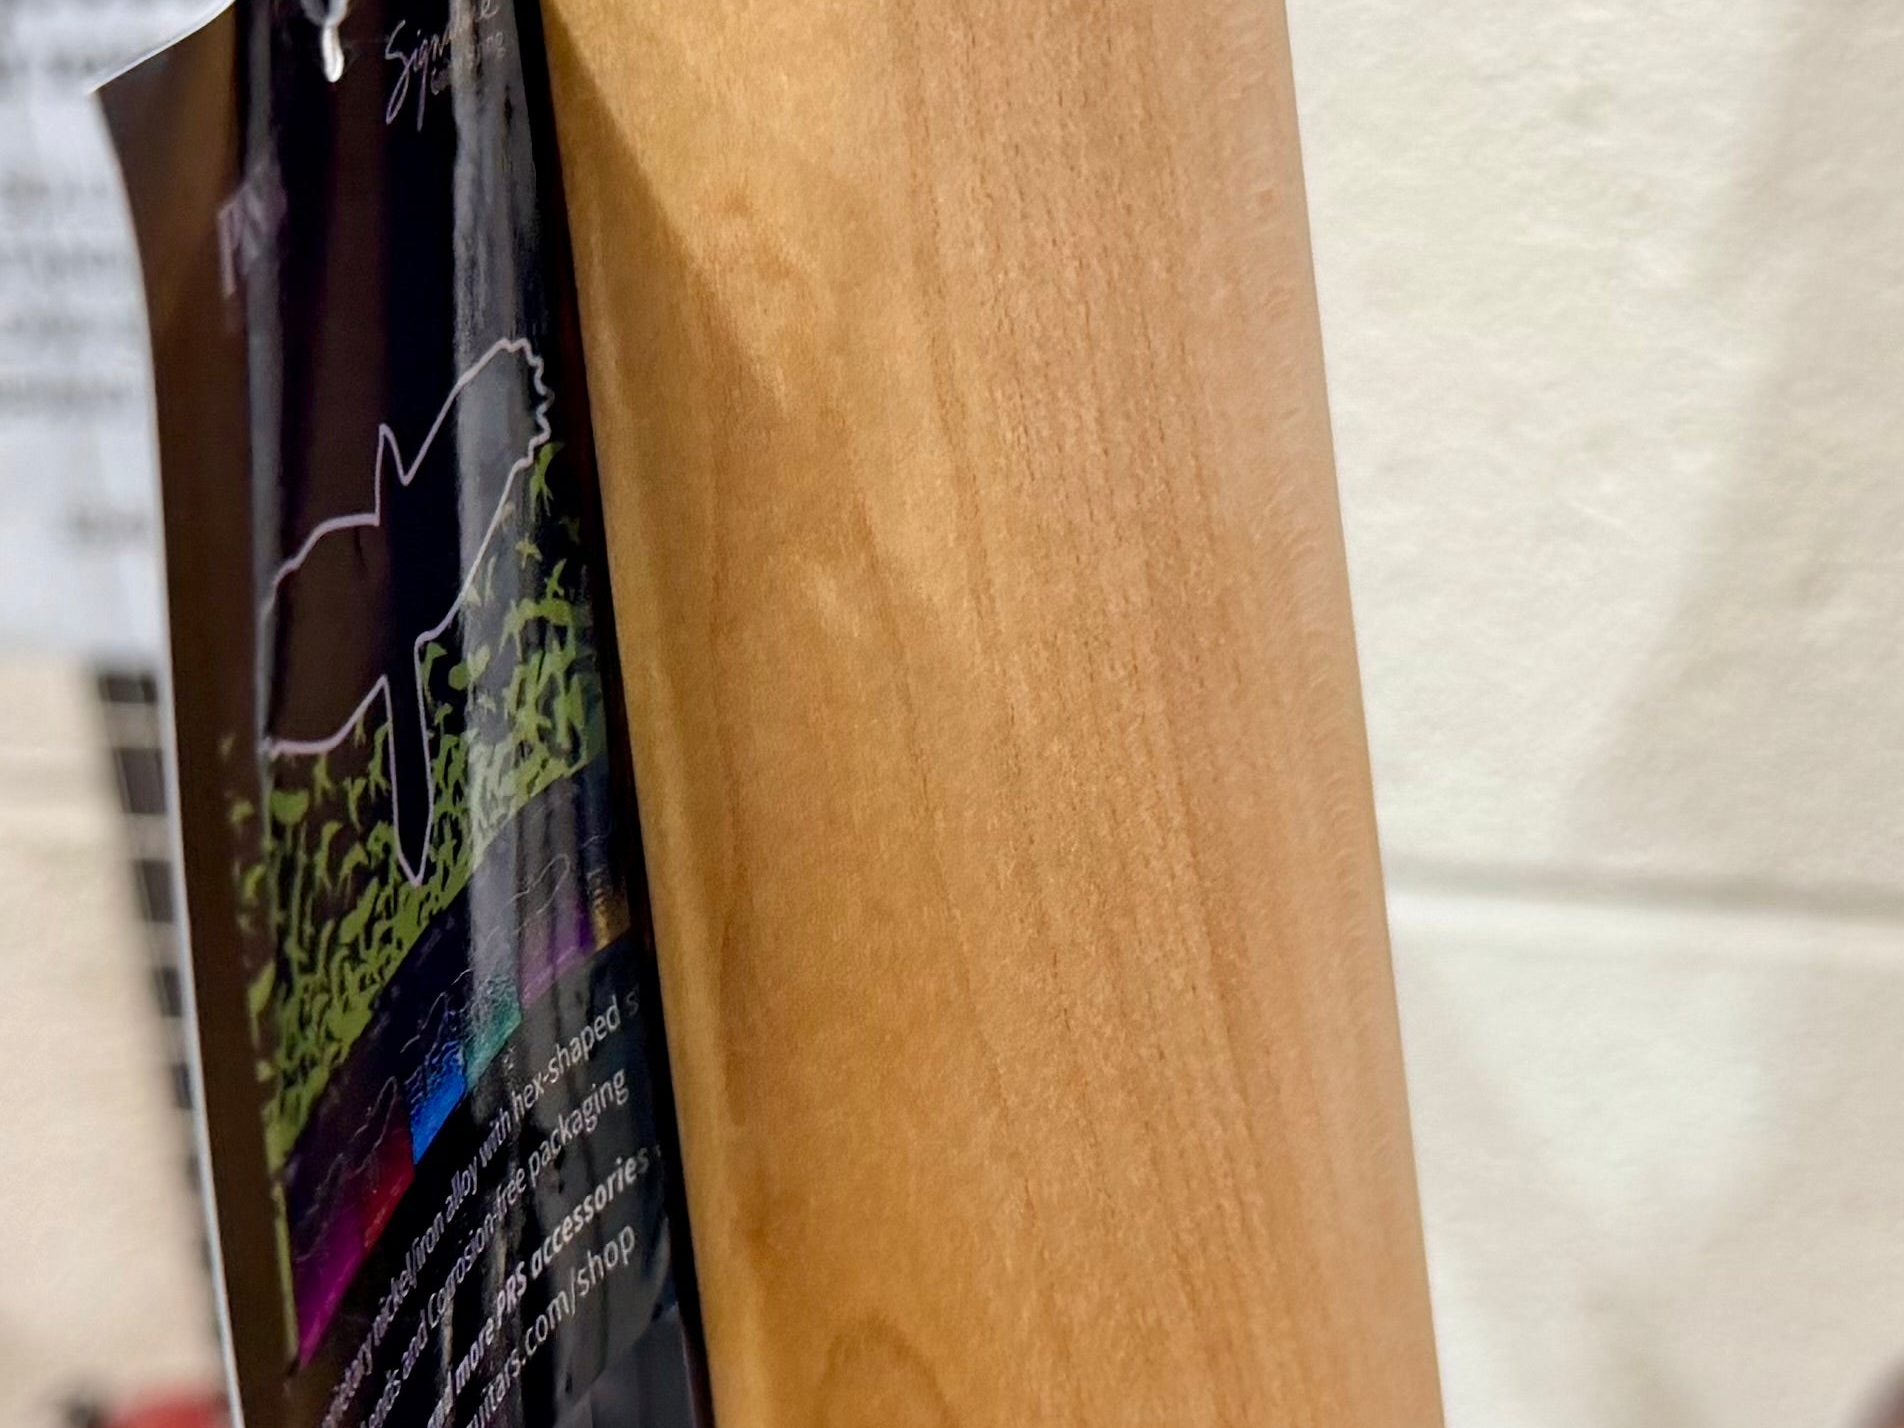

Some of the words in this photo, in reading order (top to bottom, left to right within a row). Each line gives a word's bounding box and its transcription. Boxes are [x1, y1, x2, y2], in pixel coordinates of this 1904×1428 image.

[403, 1308, 428, 1380] and
[528, 1069, 629, 1188] packaging
[445, 1156, 478, 1223] alloy
[479, 1106, 512, 1168] with
[511, 994, 621, 1118] hex-shaped
[455, 1317, 495, 1395] more
[497, 1260, 527, 1331] PRS
[531, 1146, 650, 1280] accessories
